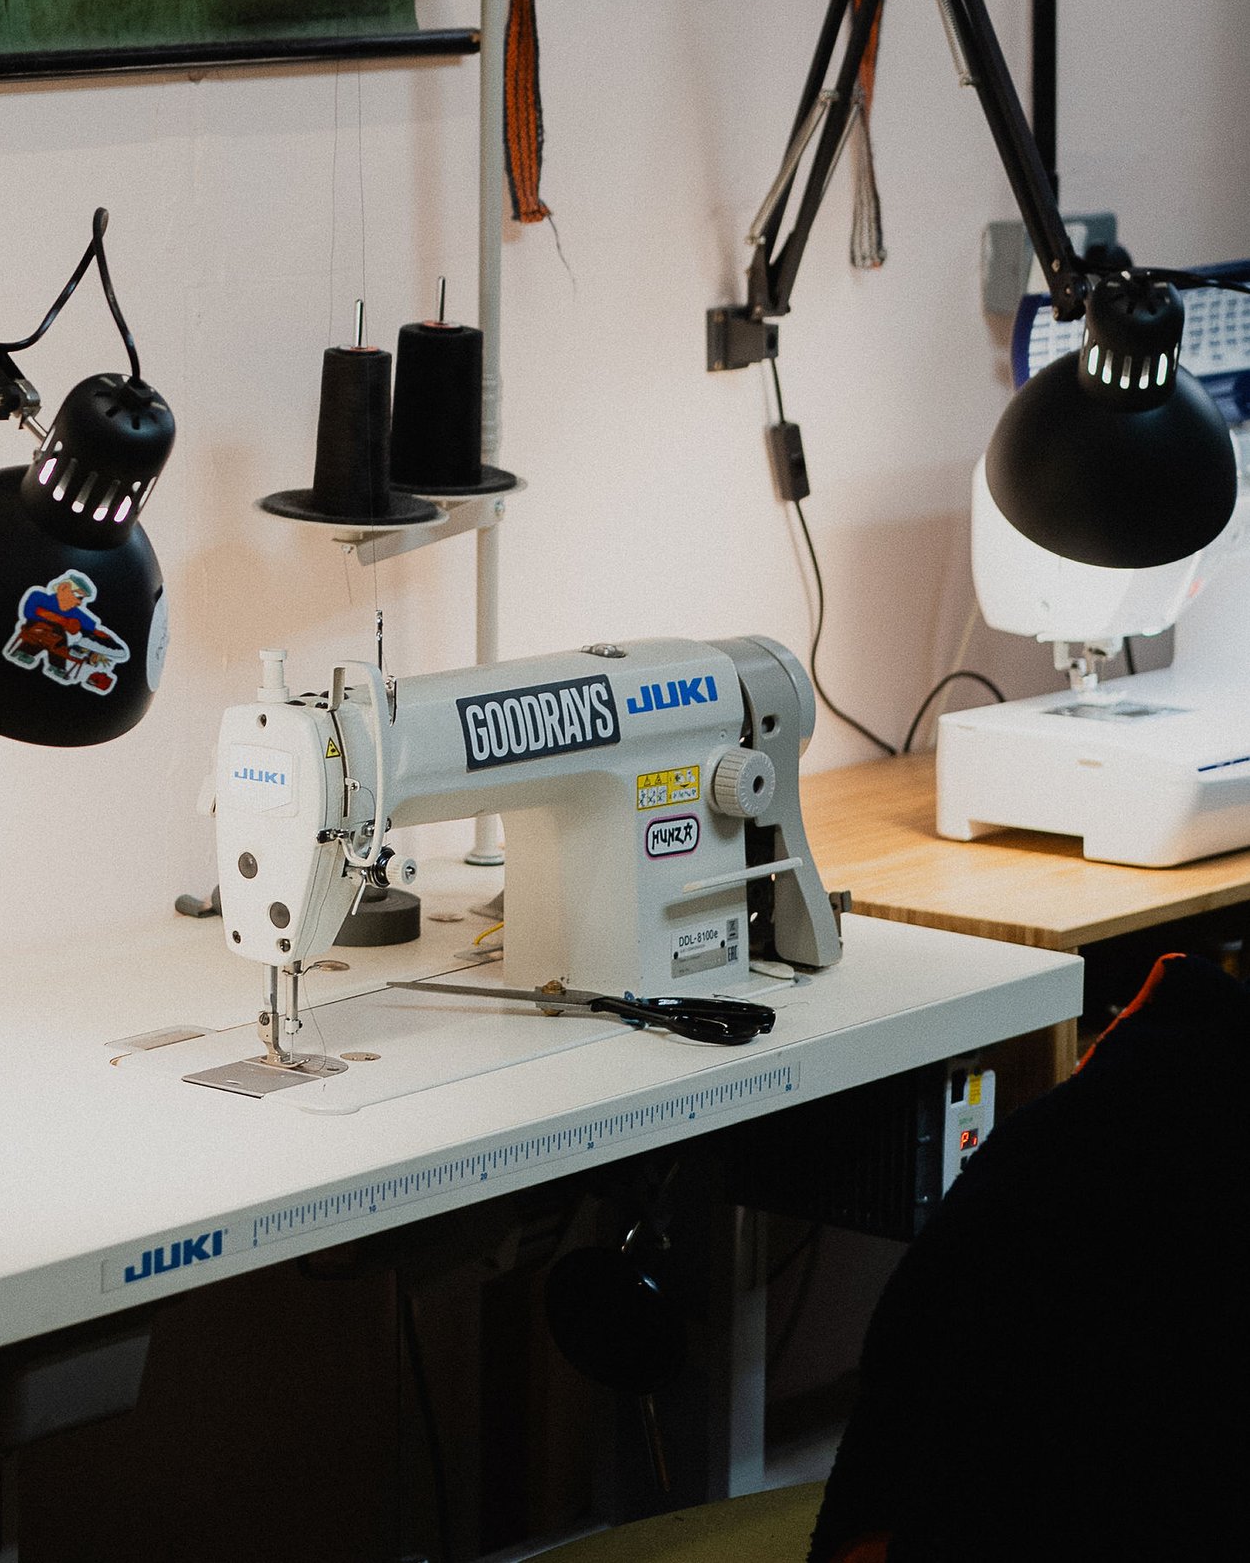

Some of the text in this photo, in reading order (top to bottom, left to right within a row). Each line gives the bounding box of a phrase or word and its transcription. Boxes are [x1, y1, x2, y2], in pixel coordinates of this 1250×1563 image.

[625, 675, 719, 716] JUKI
[464, 687, 615, 762] GOODRAYS
[234, 767, 285, 785] JUKI
[678, 928, 718, 947] DDL-8100e
[784, 1083, 793, 1092] 50
[687, 1111, 696, 1120] 40
[586, 1141, 595, 1150] 30
[480, 1172, 488, 1181] 20
[368, 1205, 377, 1214] 10
[124, 1229, 222, 1284] JUKI
